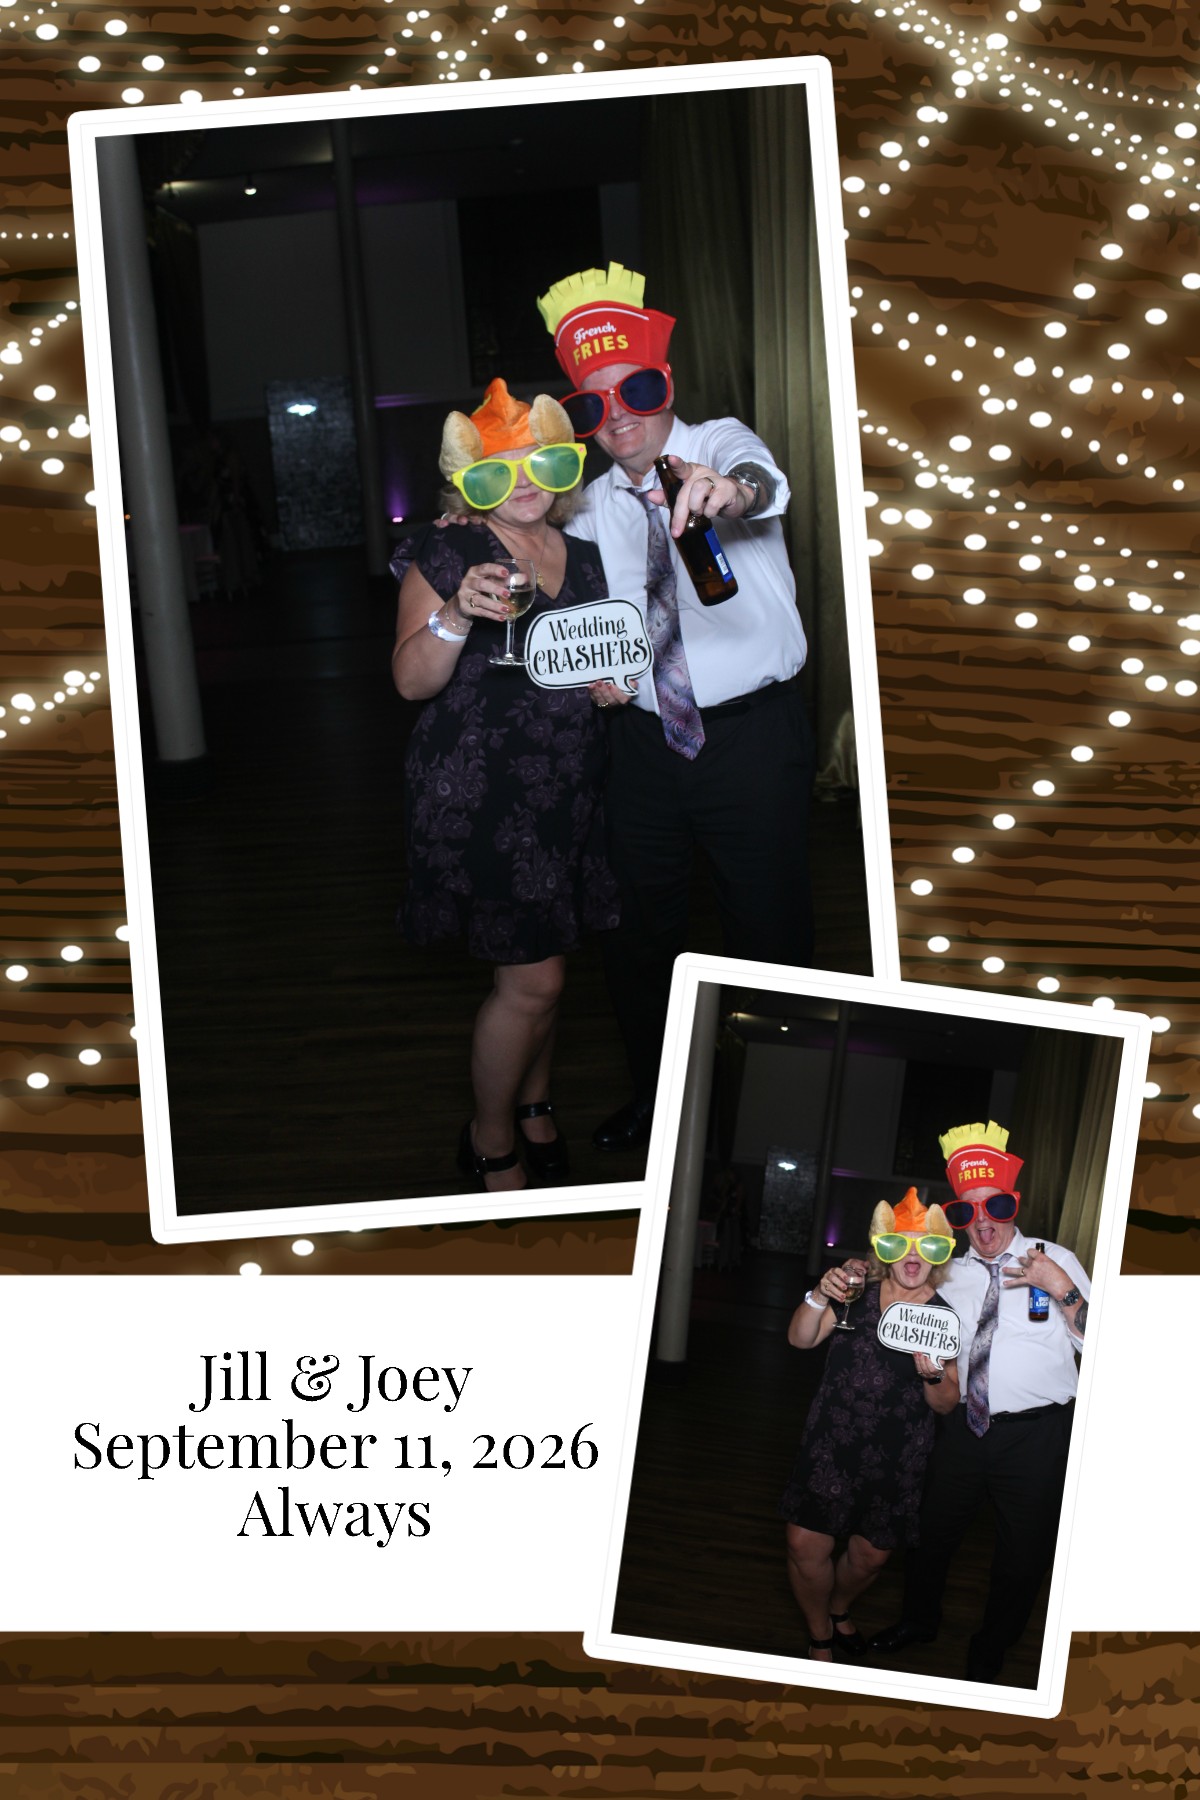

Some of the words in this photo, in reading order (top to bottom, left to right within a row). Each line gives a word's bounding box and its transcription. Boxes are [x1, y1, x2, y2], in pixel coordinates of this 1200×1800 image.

[573, 321, 617, 346] French
[573, 334, 629, 366] FRIES
[549, 615, 628, 642] Wedding
[533, 637, 648, 676] CRASHERS
[958, 1167, 995, 1184] FRIES
[960, 1158, 989, 1171] French
[899, 1307, 949, 1333] Wedding
[882, 1321, 958, 1351] CRASHERS
